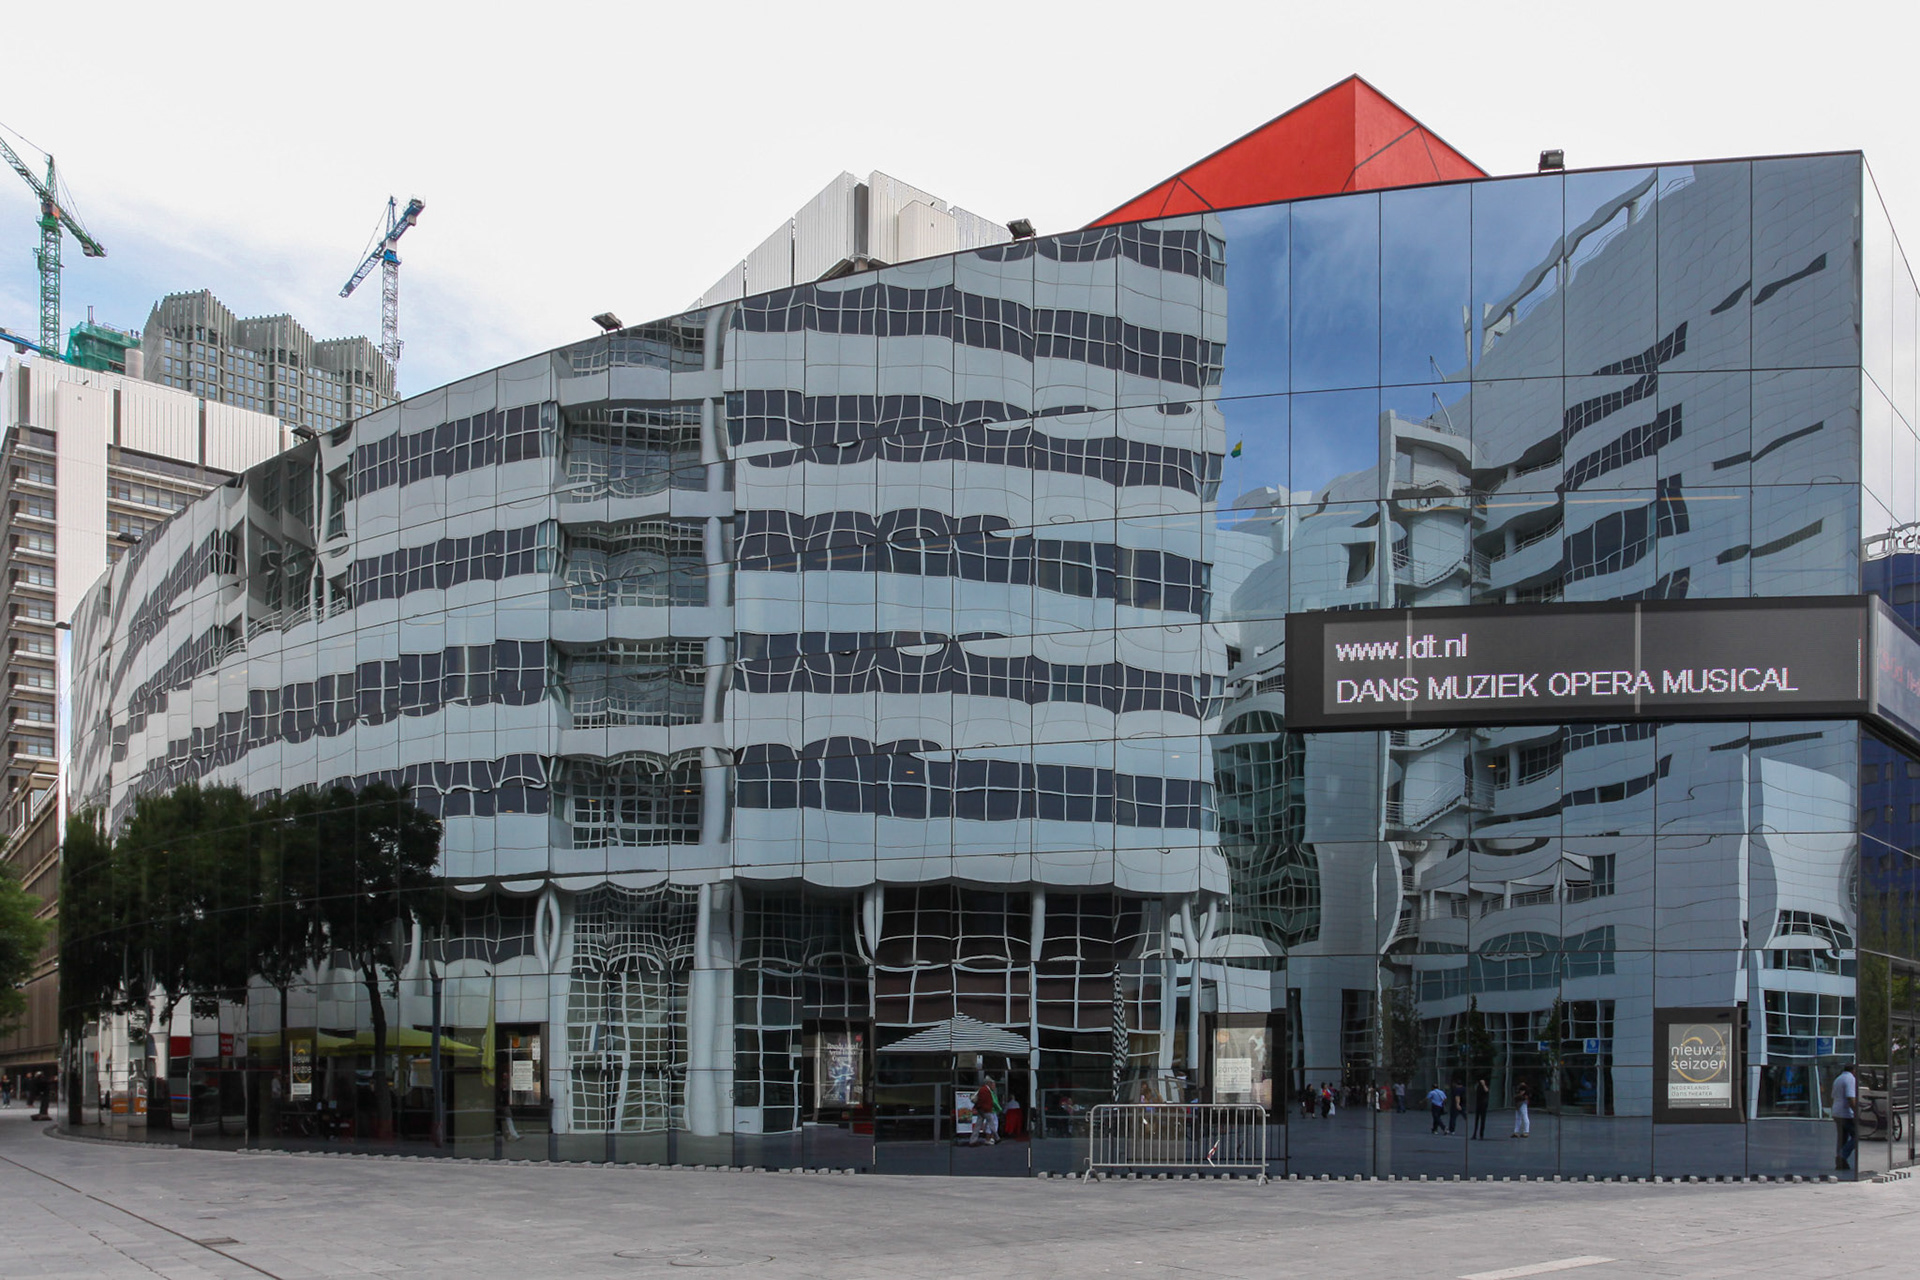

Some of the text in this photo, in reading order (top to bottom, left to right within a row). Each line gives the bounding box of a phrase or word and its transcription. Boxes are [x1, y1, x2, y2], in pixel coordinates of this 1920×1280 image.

[1335, 633, 1468, 661] www.ldt.nl
[1336, 667, 1799, 703] DANS MUZIEK OPERA MUSICAL
[1671, 1044, 1713, 1056] nieuw
[1671, 1057, 1727, 1070] seizoen
